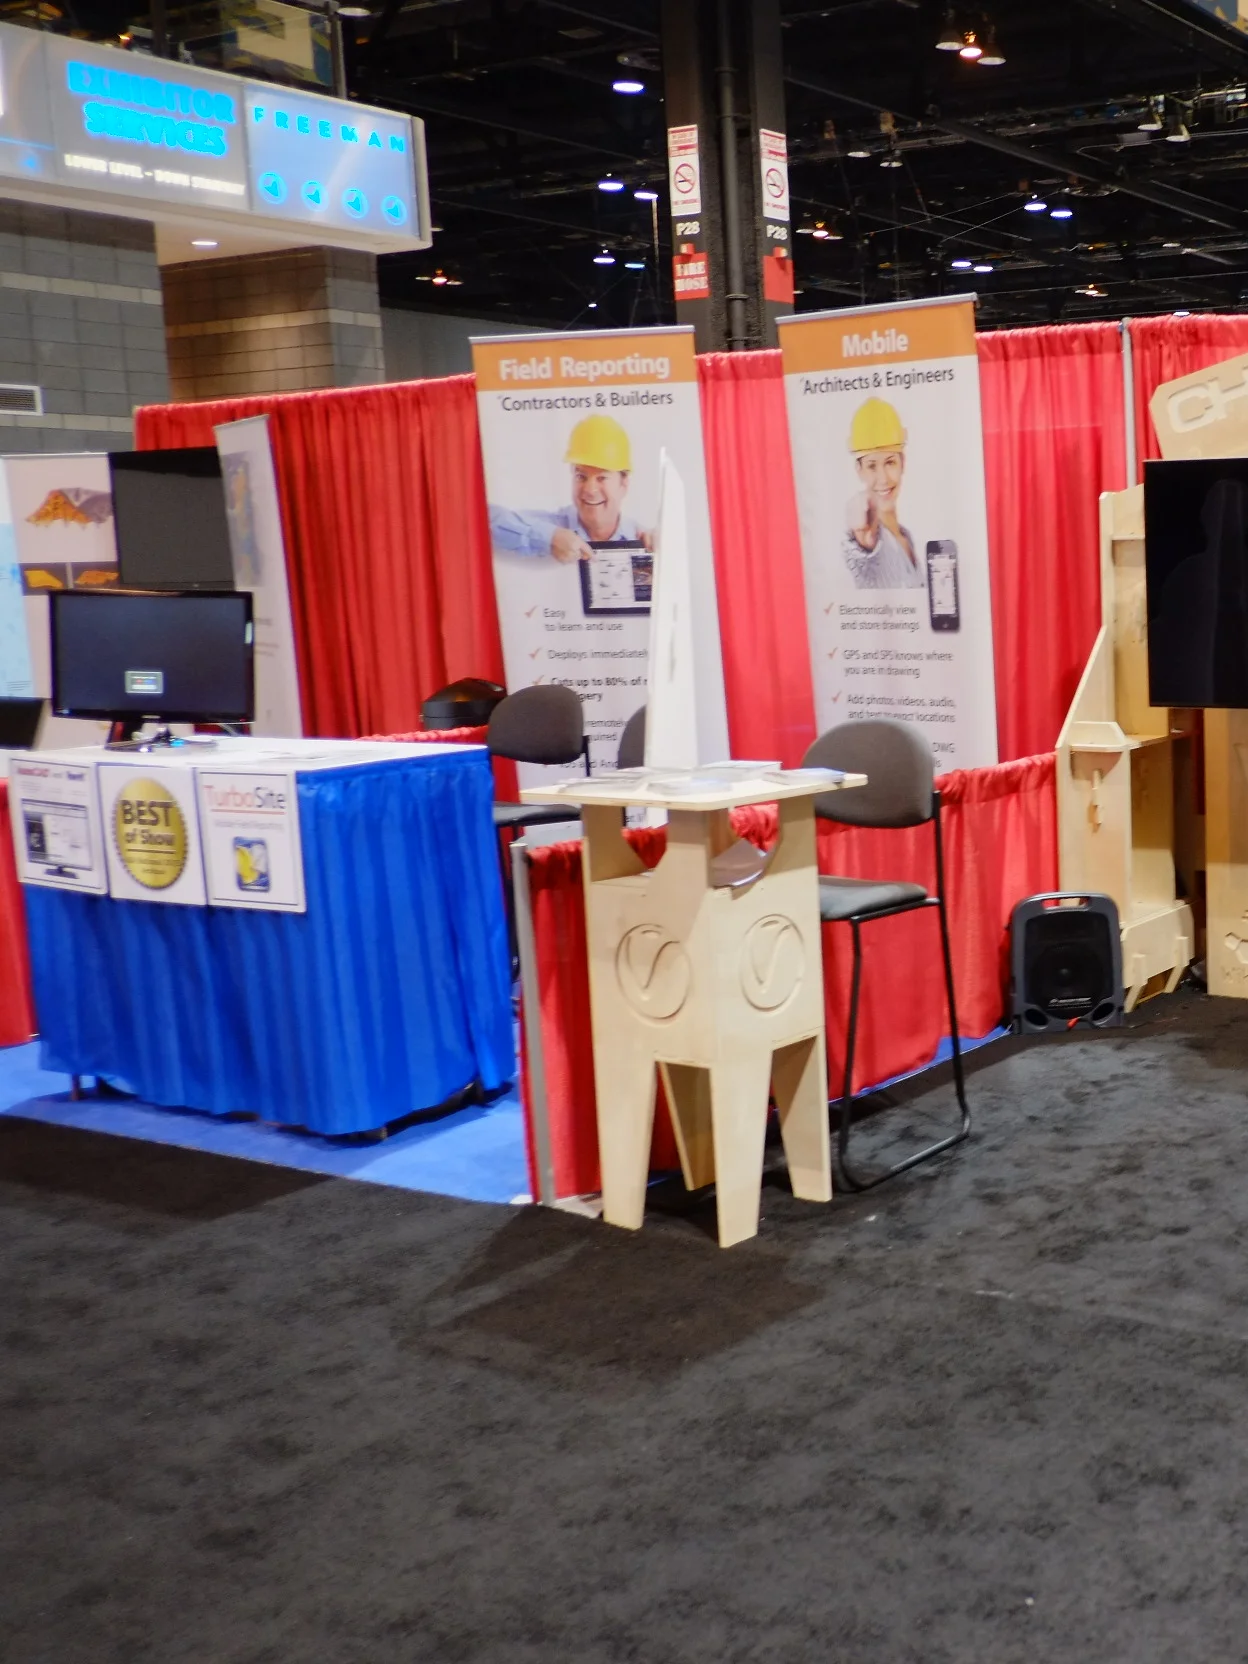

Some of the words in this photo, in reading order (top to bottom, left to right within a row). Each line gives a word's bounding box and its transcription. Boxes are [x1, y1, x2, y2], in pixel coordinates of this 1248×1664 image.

[254, 107, 404, 152] FREEMAN
[842, 328, 909, 357] Mobile
[500, 357, 552, 380] Field
[560, 353, 670, 382] Reporting
[803, 374, 869, 395] Architects
[873, 373, 882, 388] &
[886, 367, 954, 389] Engineers
[502, 396, 590, 411] Contractors
[596, 393, 606, 407] &
[611, 390, 673, 407] Builders
[121, 799, 175, 827] BEST
